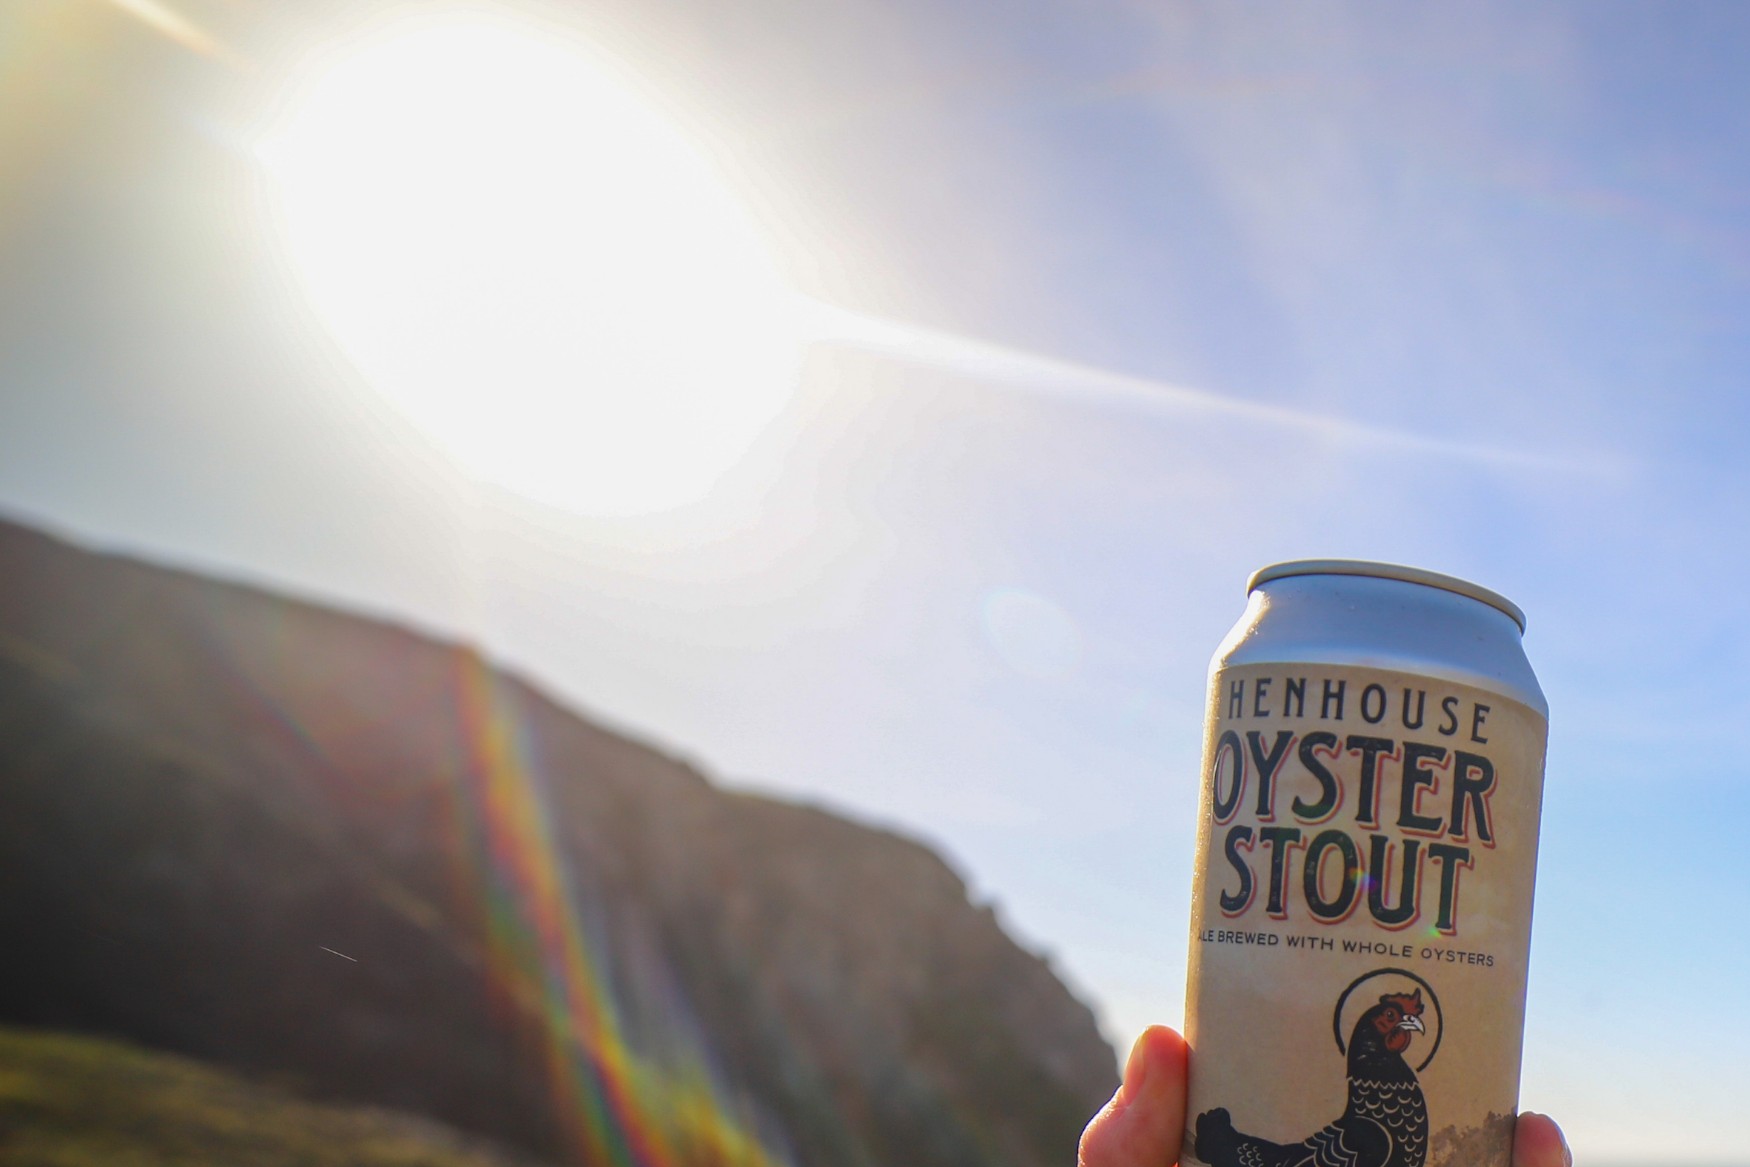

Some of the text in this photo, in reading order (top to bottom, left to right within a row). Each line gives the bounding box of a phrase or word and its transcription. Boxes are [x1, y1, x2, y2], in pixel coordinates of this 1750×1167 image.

[1228, 677, 1490, 744] HENHOUSE
[1212, 729, 1497, 849] OYSTER
[1219, 824, 1475, 936] STOUT
[1217, 930, 1279, 945] BREWED
[1286, 934, 1334, 951] WITH
[1342, 939, 1414, 957] WHOLE
[1420, 947, 1495, 967] OYSTERS
